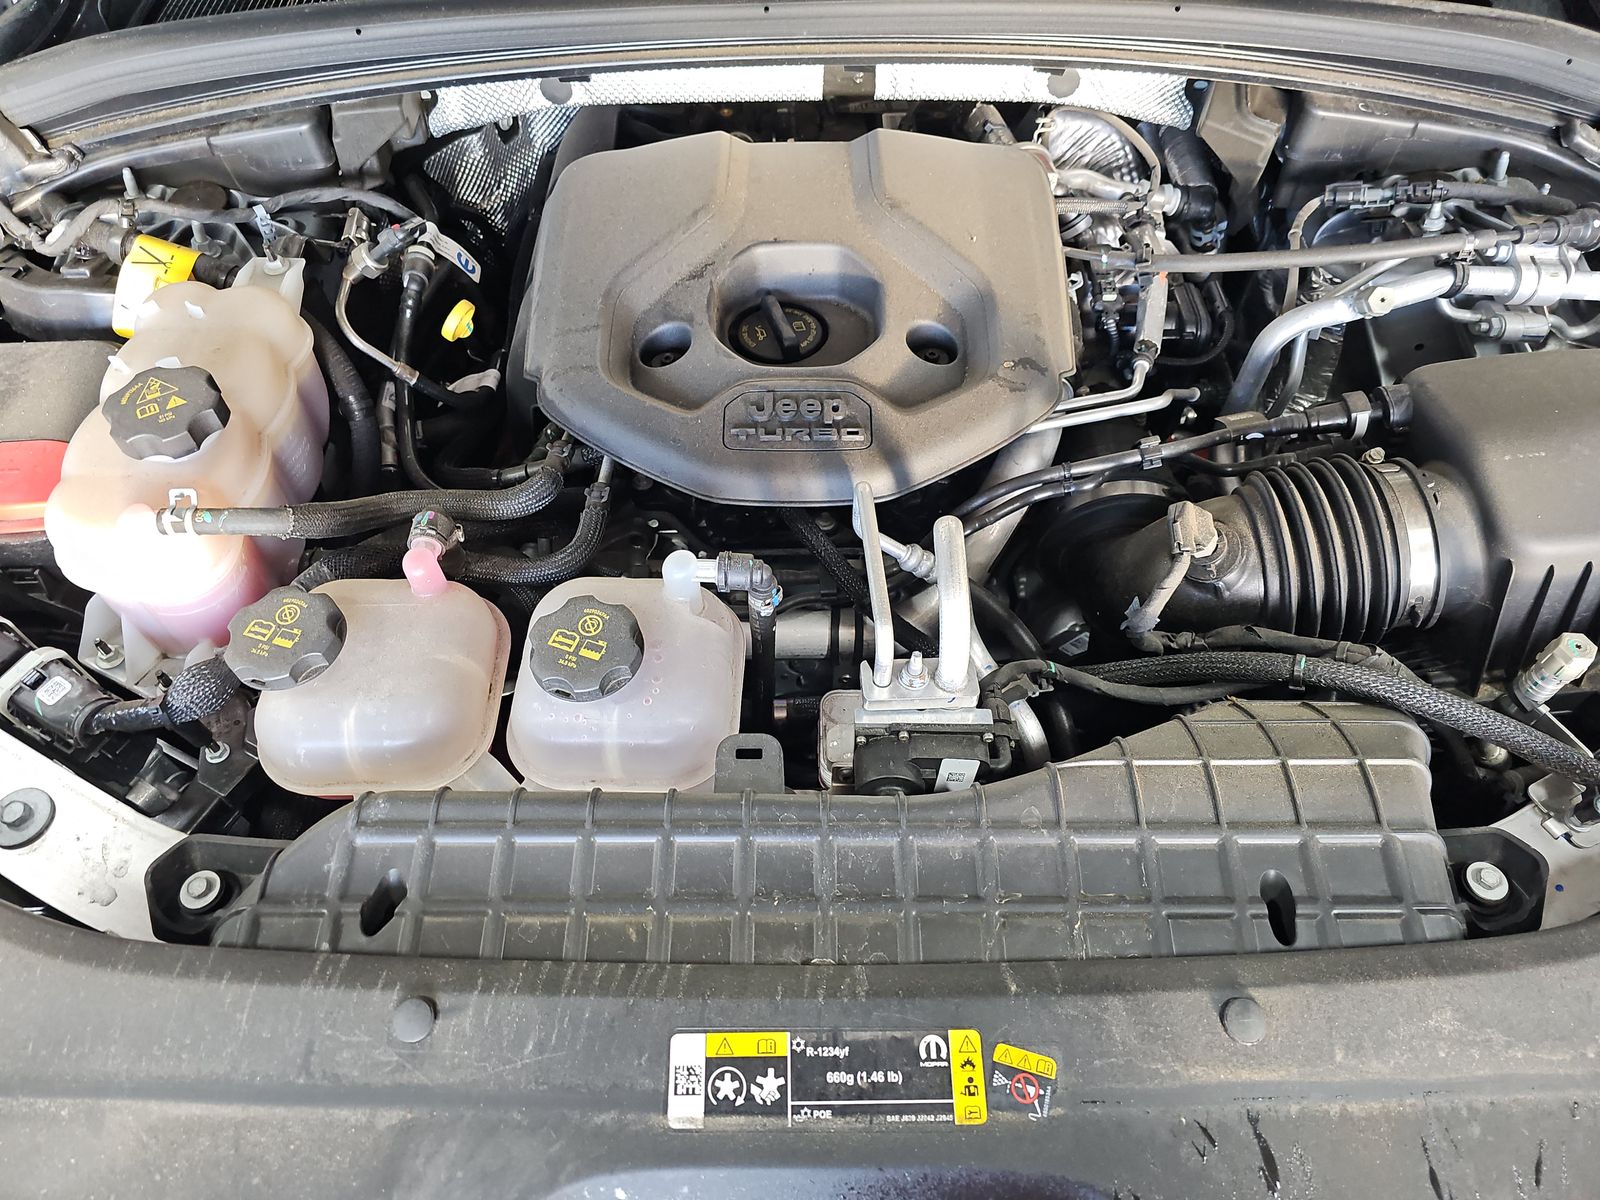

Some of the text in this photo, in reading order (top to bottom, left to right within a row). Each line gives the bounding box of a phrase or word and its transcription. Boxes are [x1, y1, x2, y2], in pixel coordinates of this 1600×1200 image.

[750, 391, 848, 424] Jeep
[730, 427, 866, 442] TURBO
[805, 1046, 850, 1059] R-1234yf
[826, 1070, 903, 1086] 660g (1.46 lb)
[812, 1109, 833, 1119] POE
